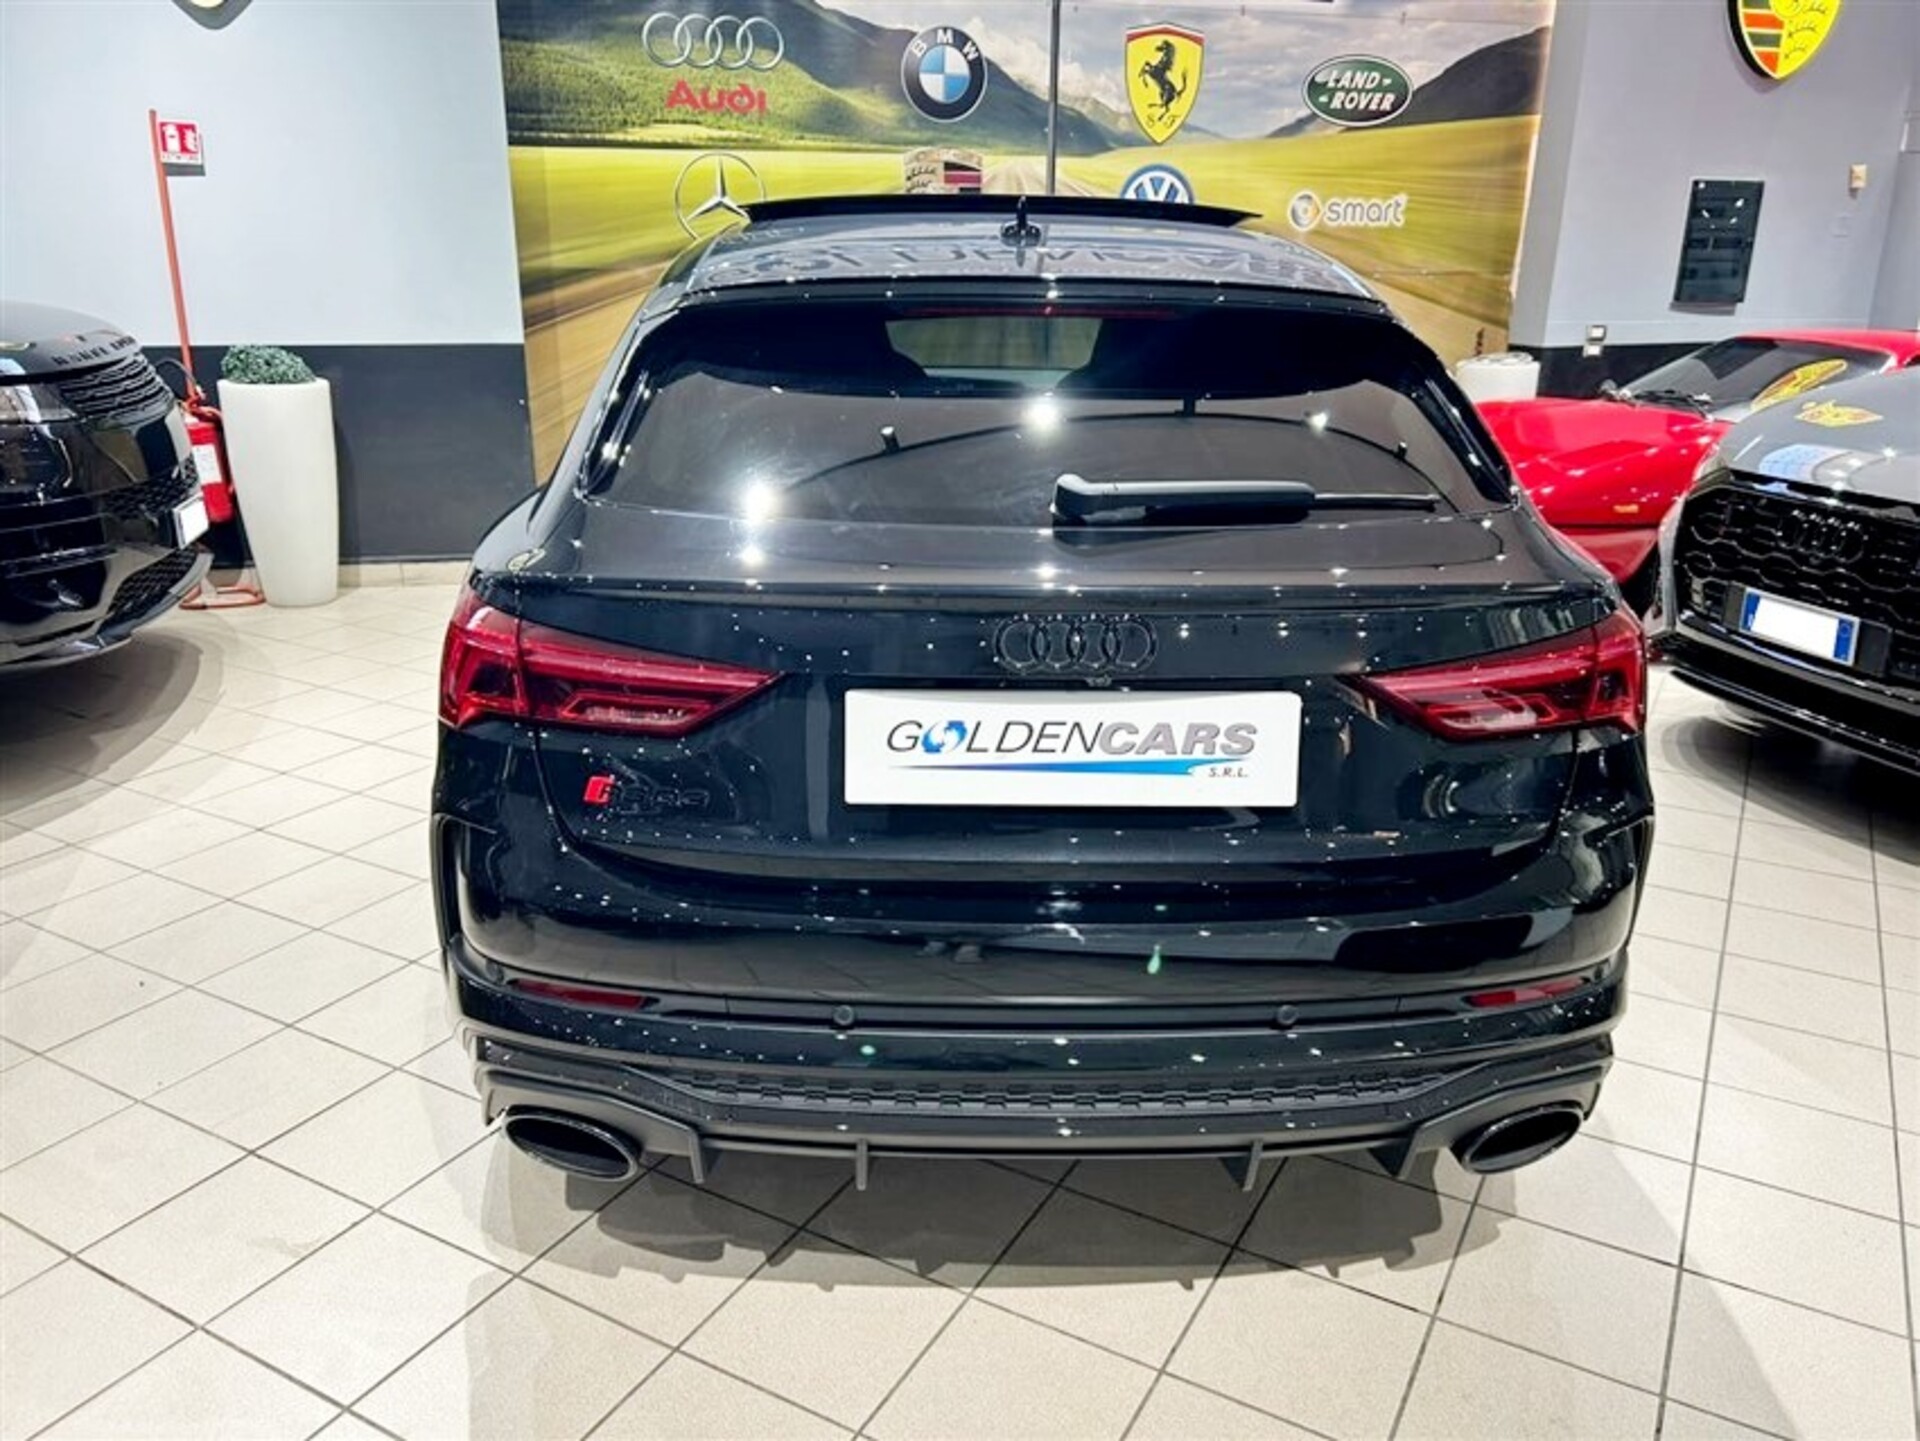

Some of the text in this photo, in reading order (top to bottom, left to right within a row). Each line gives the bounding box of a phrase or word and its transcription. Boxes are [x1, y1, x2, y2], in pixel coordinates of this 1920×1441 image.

[911, 28, 980, 60] BMW
[665, 79, 767, 114] Audi
[1329, 91, 1395, 111] ROVER
[1325, 198, 1405, 224] smart
[1208, 766, 1249, 778] S.R.L.
